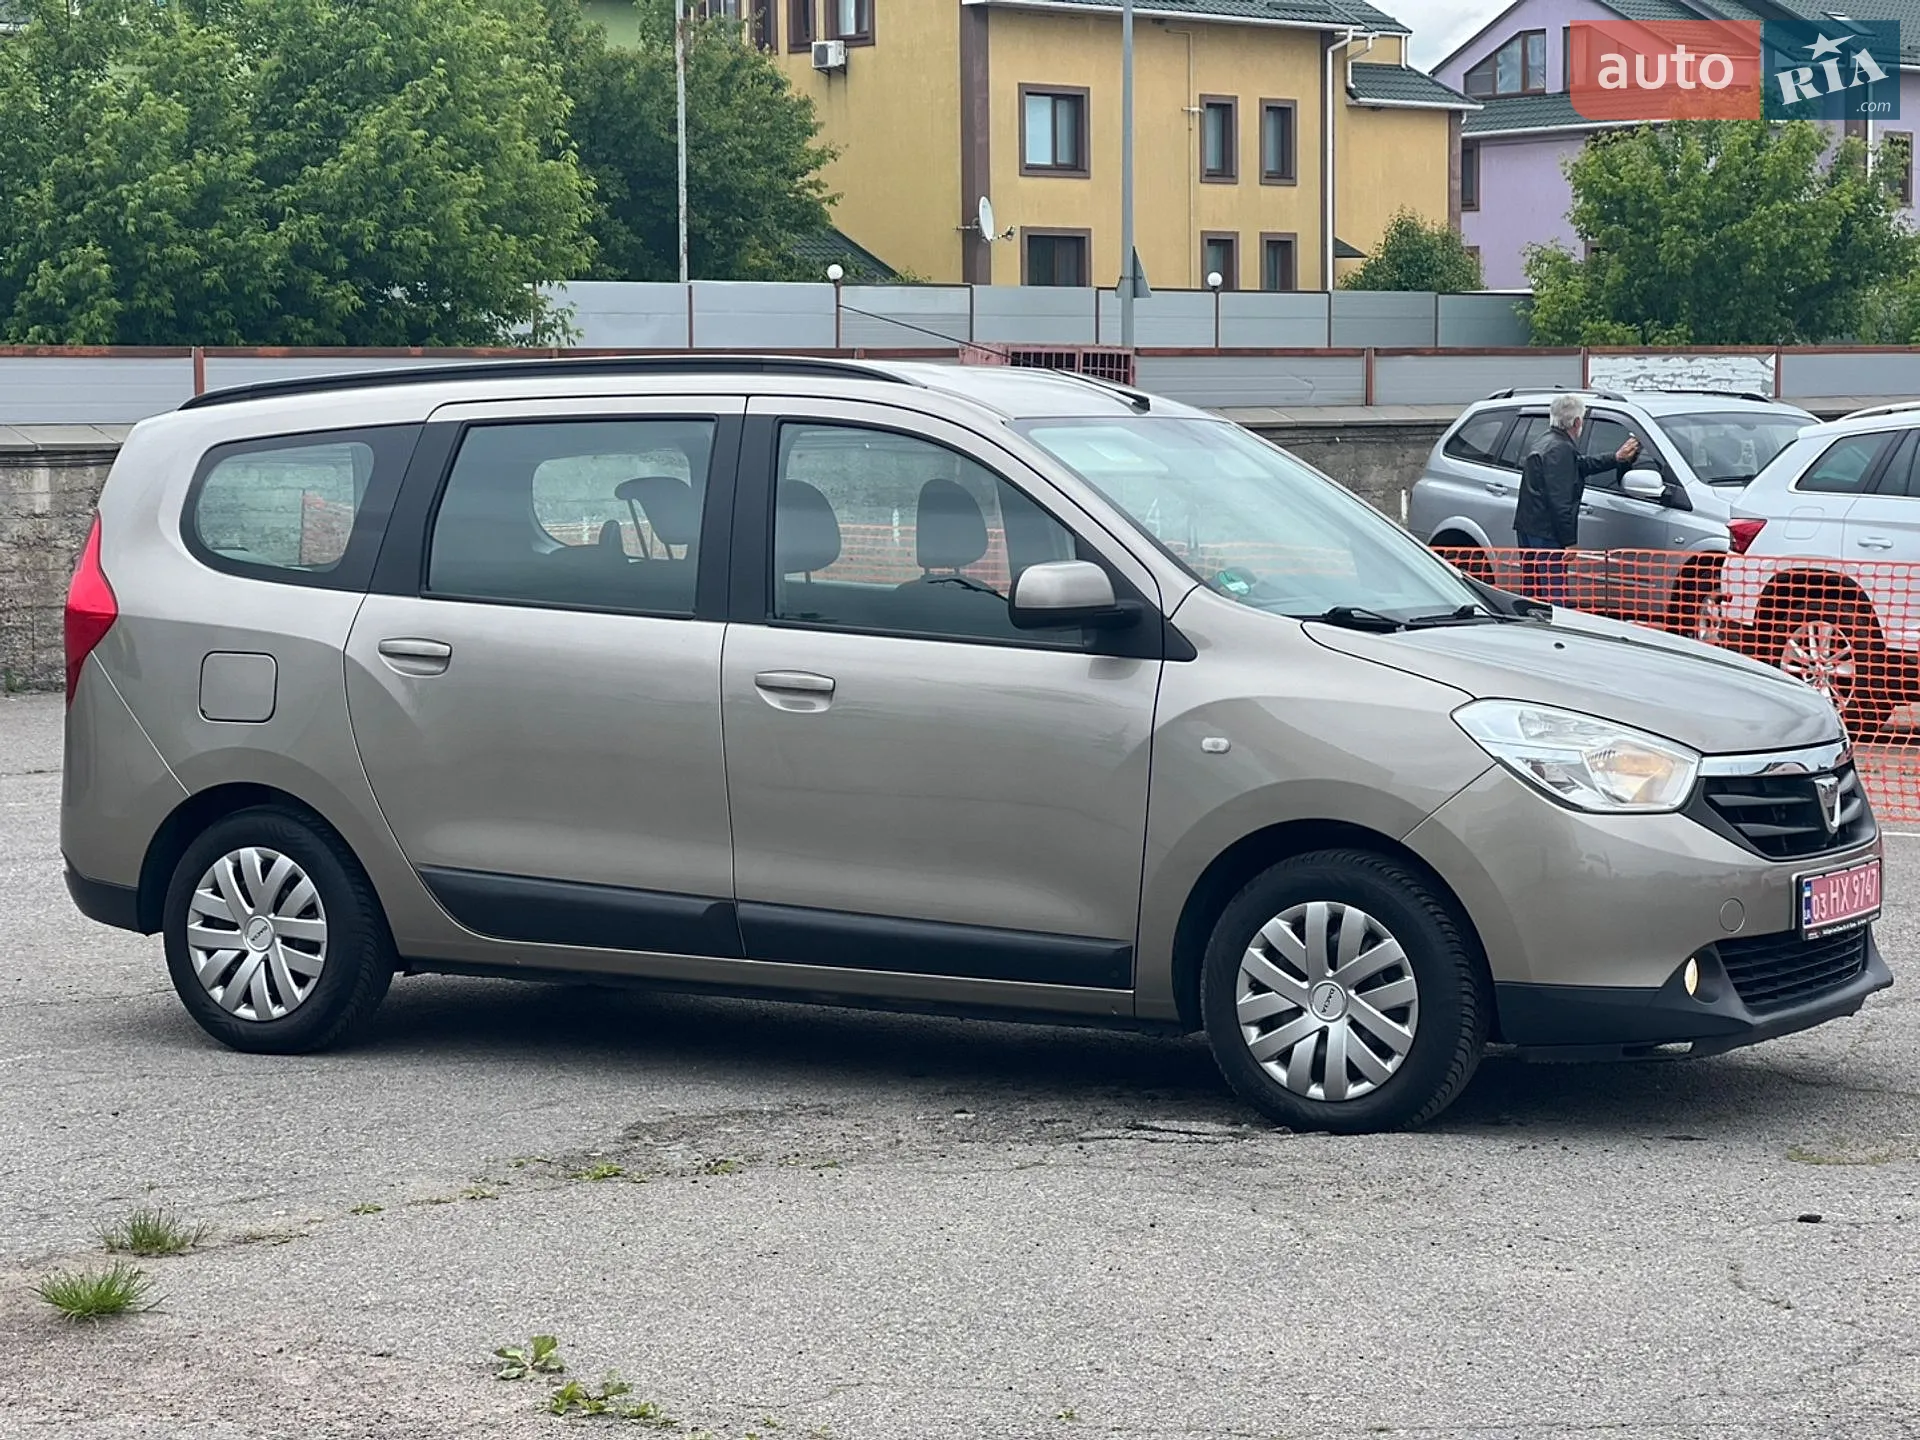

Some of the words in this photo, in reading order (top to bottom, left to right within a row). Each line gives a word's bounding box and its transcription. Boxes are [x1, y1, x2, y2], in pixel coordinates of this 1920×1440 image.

[1812, 893, 1827, 920] 03
[1829, 876, 1850, 915] HX
[1851, 868, 1878, 909] 9747
[1321, 987, 1335, 1013] DACIA
